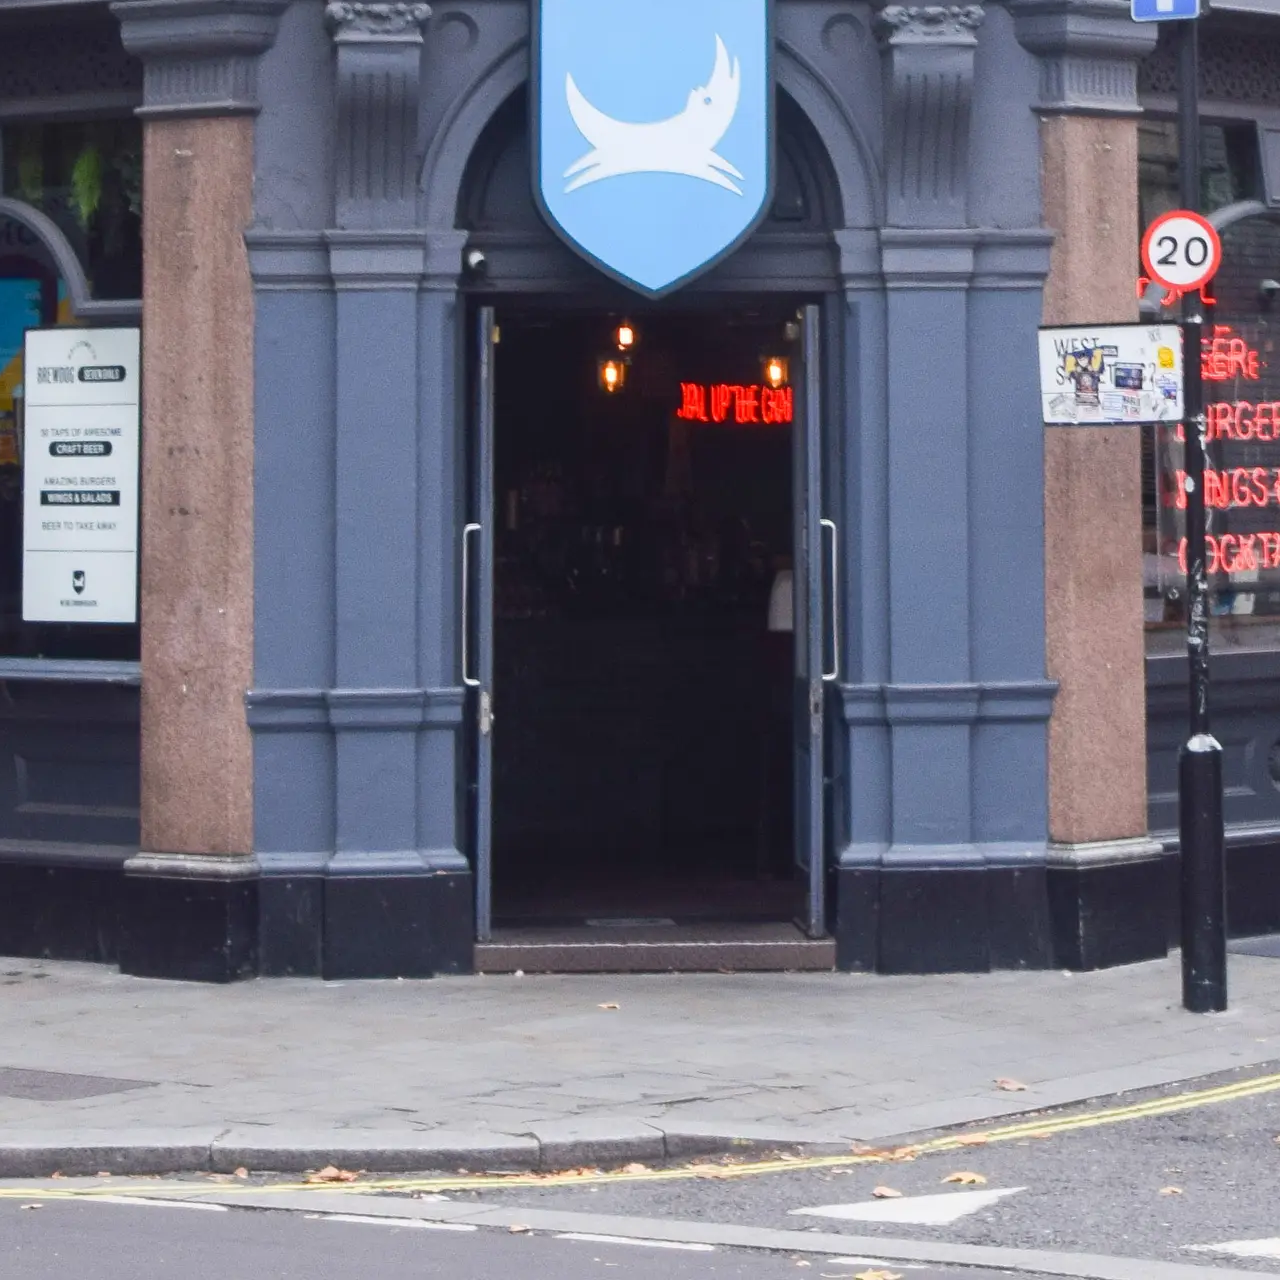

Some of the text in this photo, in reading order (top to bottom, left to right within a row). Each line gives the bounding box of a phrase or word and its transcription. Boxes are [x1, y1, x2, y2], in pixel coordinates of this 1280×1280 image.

[1156, 235, 1209, 267] 20
[56, 444, 105, 454] CRAFT BEER
[41, 521, 61, 531] BEER
